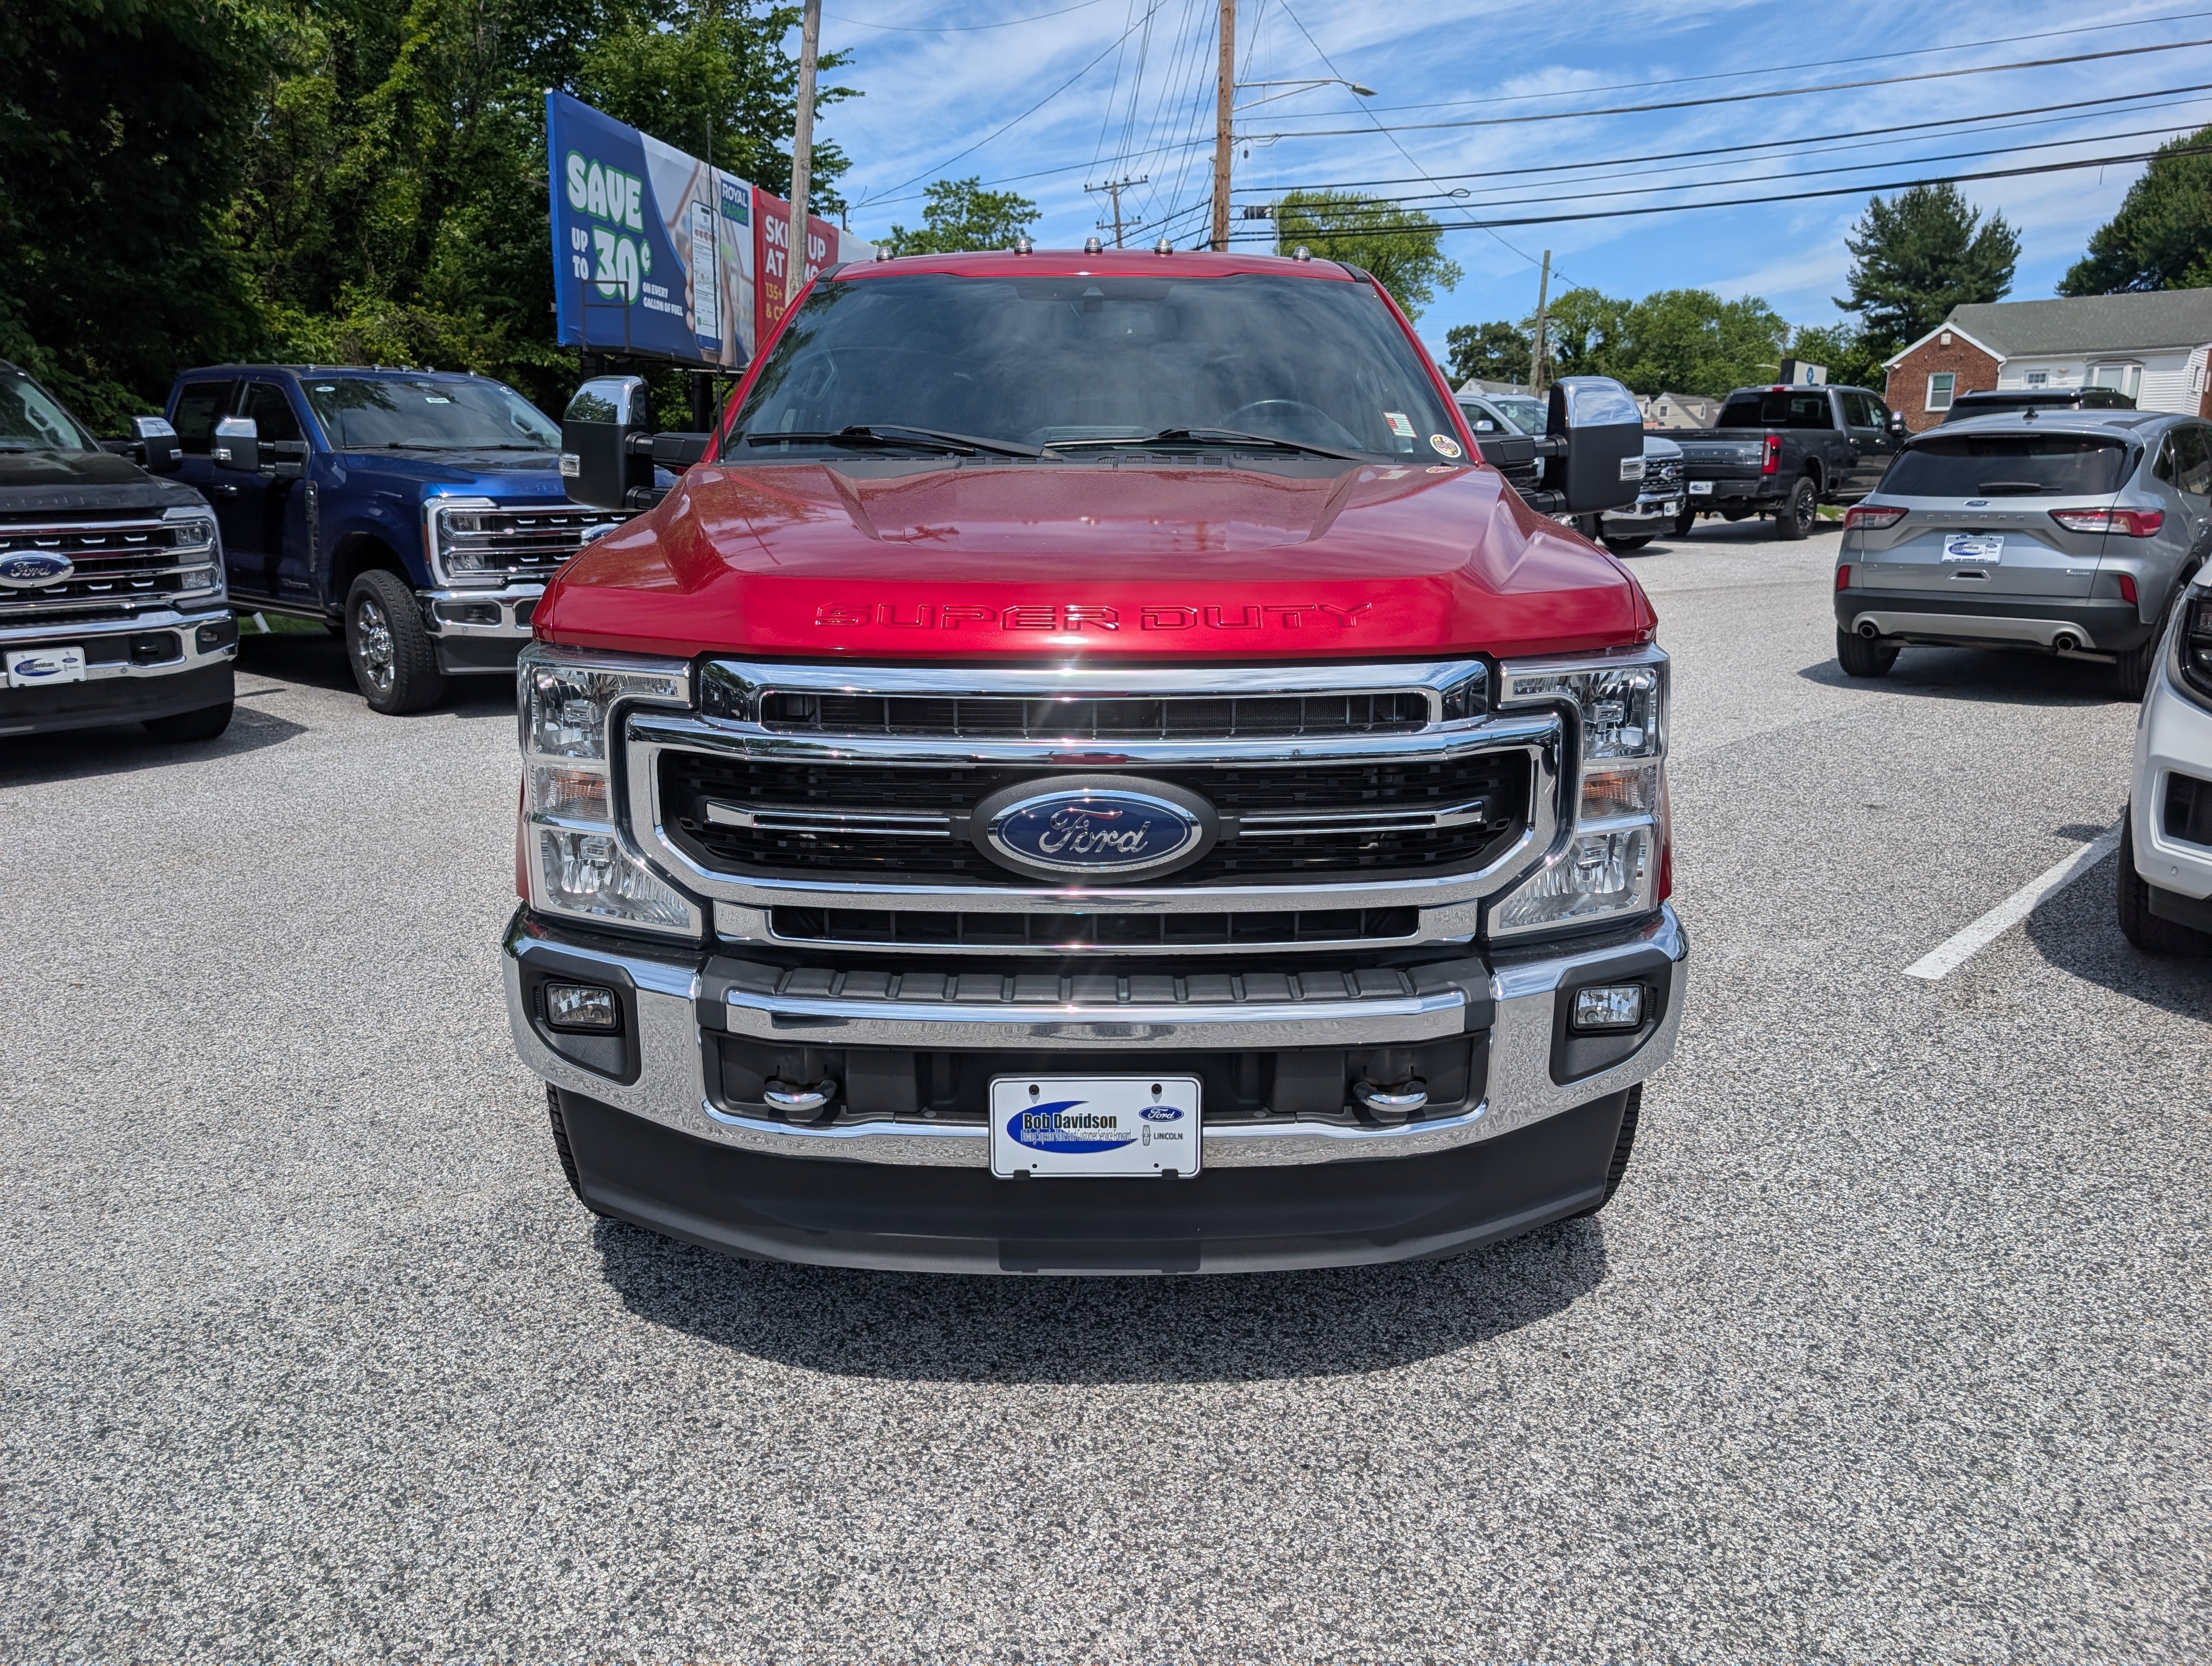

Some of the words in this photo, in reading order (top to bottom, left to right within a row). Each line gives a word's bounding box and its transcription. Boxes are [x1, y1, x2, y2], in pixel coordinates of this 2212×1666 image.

[567, 151, 643, 232] SAVE
[722, 183, 748, 208] ROYAL
[571, 227, 588, 252] UP
[808, 233, 826, 262] UP
[573, 254, 589, 280] TO
[766, 248, 785, 278] AT
[642, 281, 651, 294] ON
[651, 284, 668, 299] EVERY
[765, 281, 783, 301] 135+
[643, 296, 664, 312] GALLON
[664, 302, 671, 313] OF
[671, 303, 684, 317] FUEL
[11, 561, 52, 577] Ford
[814, 602, 1120, 632] SUPER
[1140, 602, 1373, 631] DUTY
[1039, 808, 1151, 853] Ford
[1024, 1113, 1051, 1130] Bob
[1053, 1113, 1117, 1129] Davidson
[1148, 1108, 1175, 1119] Ford
[1020, 1129, 1037, 1145] Driving
[1037, 1129, 1054, 1145] Superior
[1054, 1128, 1069, 1142] Value
[1077, 1129, 1097, 1142] Customer
[1097, 1129, 1114, 1142] Service
[1114, 1128, 1131, 1142] Forward
